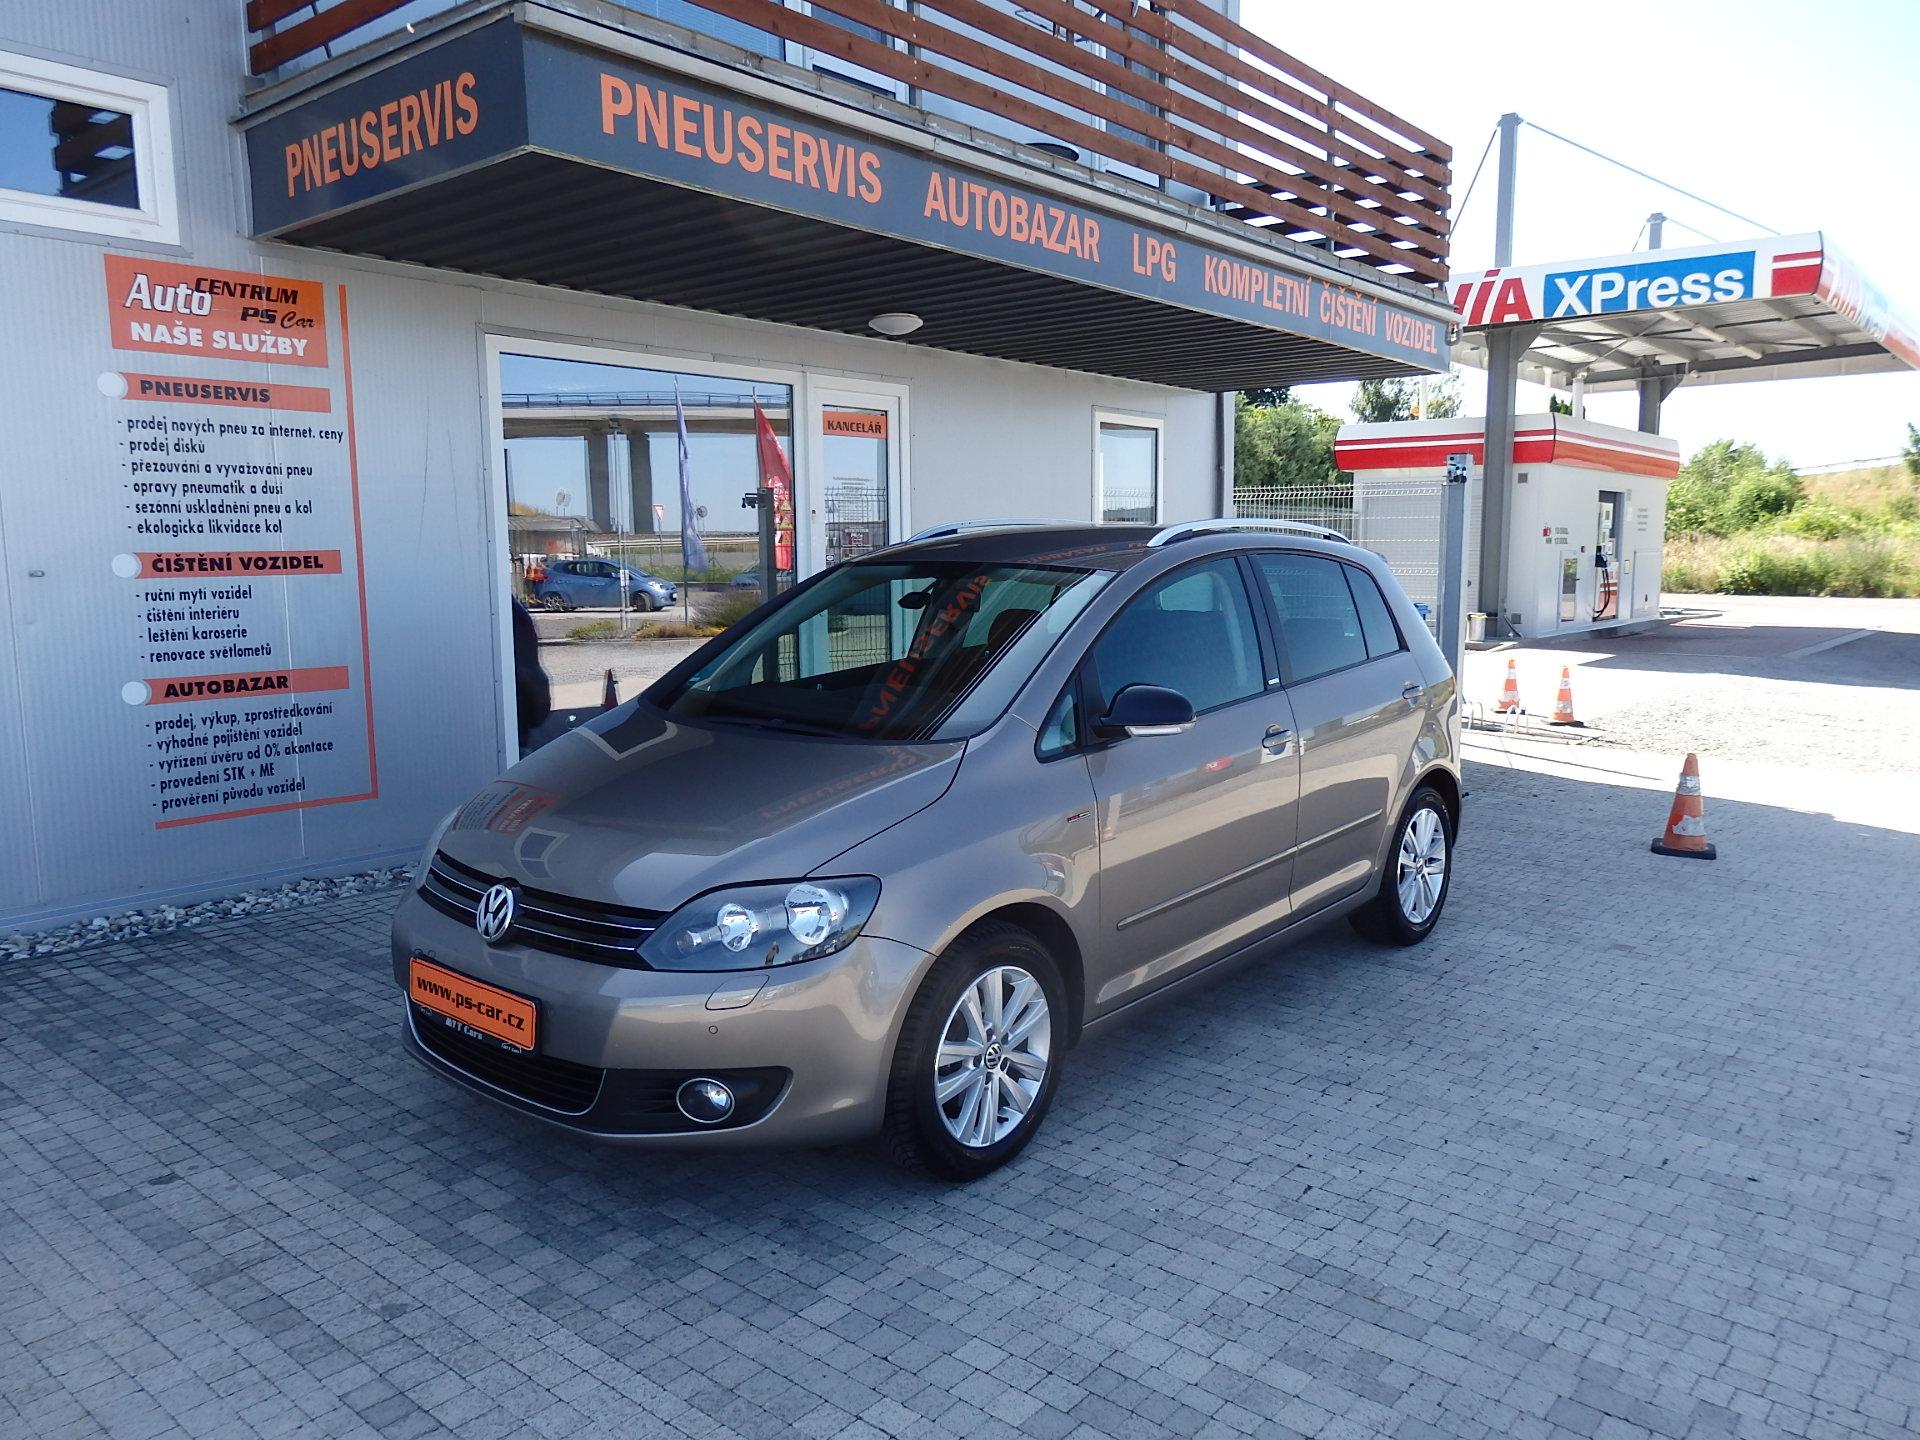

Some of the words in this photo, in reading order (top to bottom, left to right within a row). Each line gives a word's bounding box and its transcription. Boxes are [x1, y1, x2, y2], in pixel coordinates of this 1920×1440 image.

[286, 71, 479, 198] PNEUSERVIS
[600, 72, 883, 204] PNEUSERVIS
[923, 171, 1100, 263] AUTOBAZAR
[1132, 232, 1177, 283] LPG
[1204, 254, 1310, 318] KOMPLETNÍ
[1319, 277, 1377, 337] ČIŠTĚNÍ
[1384, 310, 1438, 355] VOZIDEL
[123, 272, 212, 316] Auto
[195, 277, 298, 305] CENTRUM
[1548, 267, 1745, 317] XPress
[240, 306, 278, 324] PS
[280, 310, 315, 329] Car
[130, 320, 203, 347] NAŠE
[212, 329, 308, 357] SLUŽBY
[140, 379, 271, 403] PNEUSERVIS
[127, 415, 168, 435] prodej
[171, 418, 215, 437] nových
[219, 423, 247, 437] pneu
[251, 425, 265, 436] za
[269, 422, 316, 438] internet.
[319, 429, 344, 444] ceny
[827, 420, 882, 434] KANCELÁŘ
[129, 437, 169, 456] prodej
[131, 459, 200, 476] přezouvání
[204, 464, 212, 474] a
[216, 461, 283, 478] vyvažování
[286, 466, 313, 479] pneu
[133, 482, 177, 497] opravy
[182, 479, 246, 497] pneumatik
[250, 485, 257, 494] a
[135, 499, 182, 514] sezónní
[186, 498, 250, 514] uskladnění
[253, 504, 281, 517] pneu
[284, 505, 292, 514] a
[295, 499, 313, 514] kol
[137, 518, 204, 537] ekologická
[208, 518, 261, 534] likvidace
[265, 518, 283, 534] kol
[152, 553, 232, 572] ČIŠTĚNÍ
[239, 555, 324, 571] VOZIDEL
[145, 587, 175, 602] ruční
[211, 585, 252, 600] vozidel
[147, 607, 185, 622] čištění
[189, 605, 239, 621] interiéru
[148, 628, 189, 642] leštění
[192, 624, 247, 640] karoserie
[150, 650, 205, 663] renovace
[210, 643, 272, 660] světlometů
[164, 675, 289, 698] AUTOBAZAR
[155, 713, 197, 734] prodej,
[201, 711, 240, 729] výkup,
[244, 702, 333, 722] zprostředkování
[156, 733, 209, 754] výhodné
[213, 728, 260, 748] pojištění
[264, 722, 303, 739] vozidel
[158, 752, 208, 773] vyřízení
[211, 748, 243, 765] úvěru
[247, 744, 261, 760] od
[264, 743, 280, 758] 0%
[284, 740, 334, 756] akontace
[160, 771, 220, 793] provedení
[223, 766, 245, 782] STK
[259, 762, 275, 778] ME
[162, 790, 218, 813] prověření
[223, 783, 263, 804] původu
[267, 777, 306, 794] vozidel
[417, 976, 525, 1031] www.ps-car.cz
